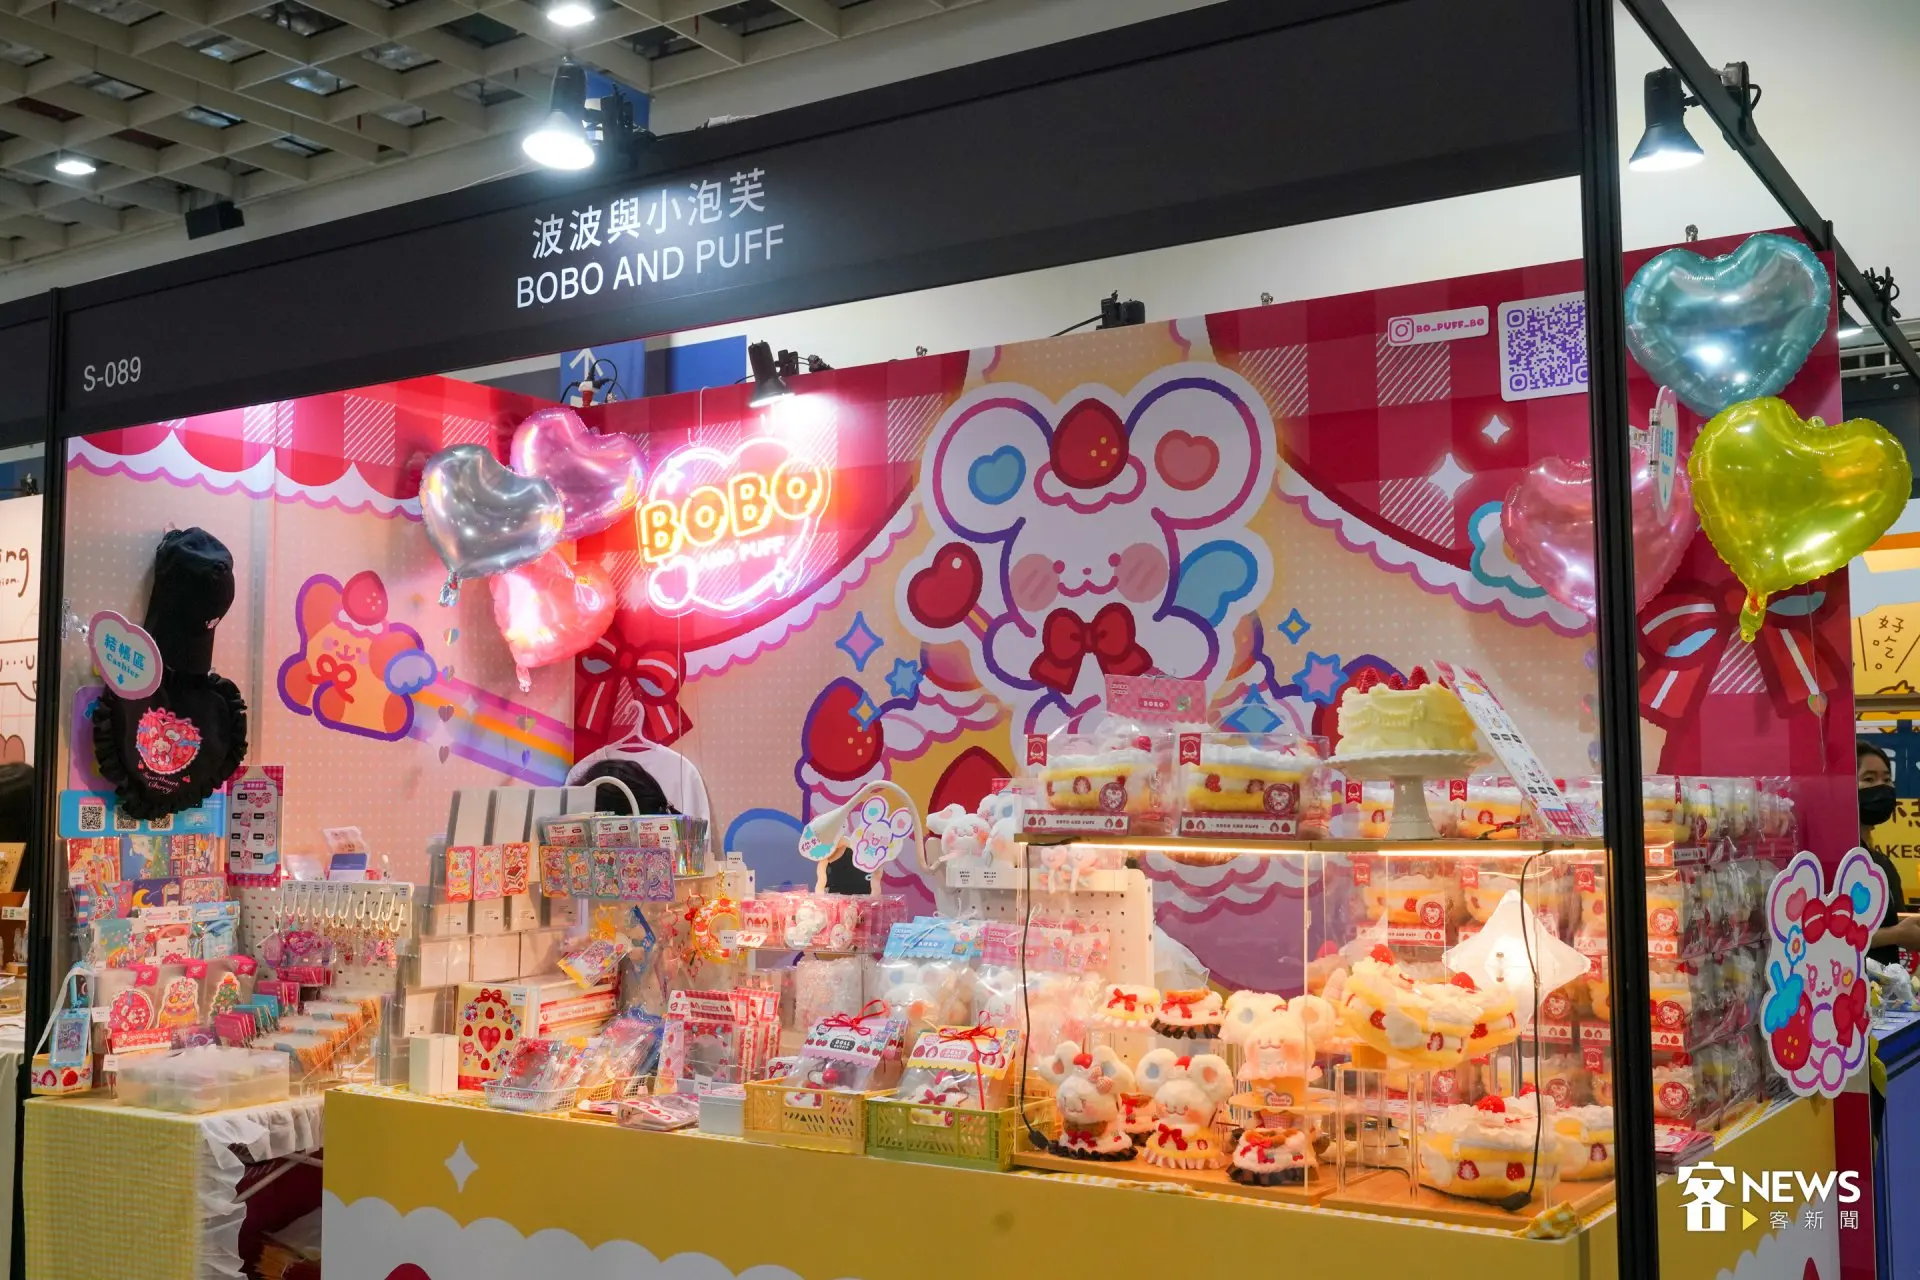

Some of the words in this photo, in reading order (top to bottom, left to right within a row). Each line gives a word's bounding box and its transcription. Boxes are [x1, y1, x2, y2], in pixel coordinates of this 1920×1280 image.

[531, 167, 766, 260] 波波與小泡芙
[516, 261, 604, 309] BOBO
[612, 245, 685, 291] AND
[695, 223, 785, 274] PUFF
[1416, 318, 1485, 333] BO_PUFF_BO
[83, 355, 142, 392] S-089
[639, 458, 824, 563] BOBO
[104, 632, 146, 671] 結帳區
